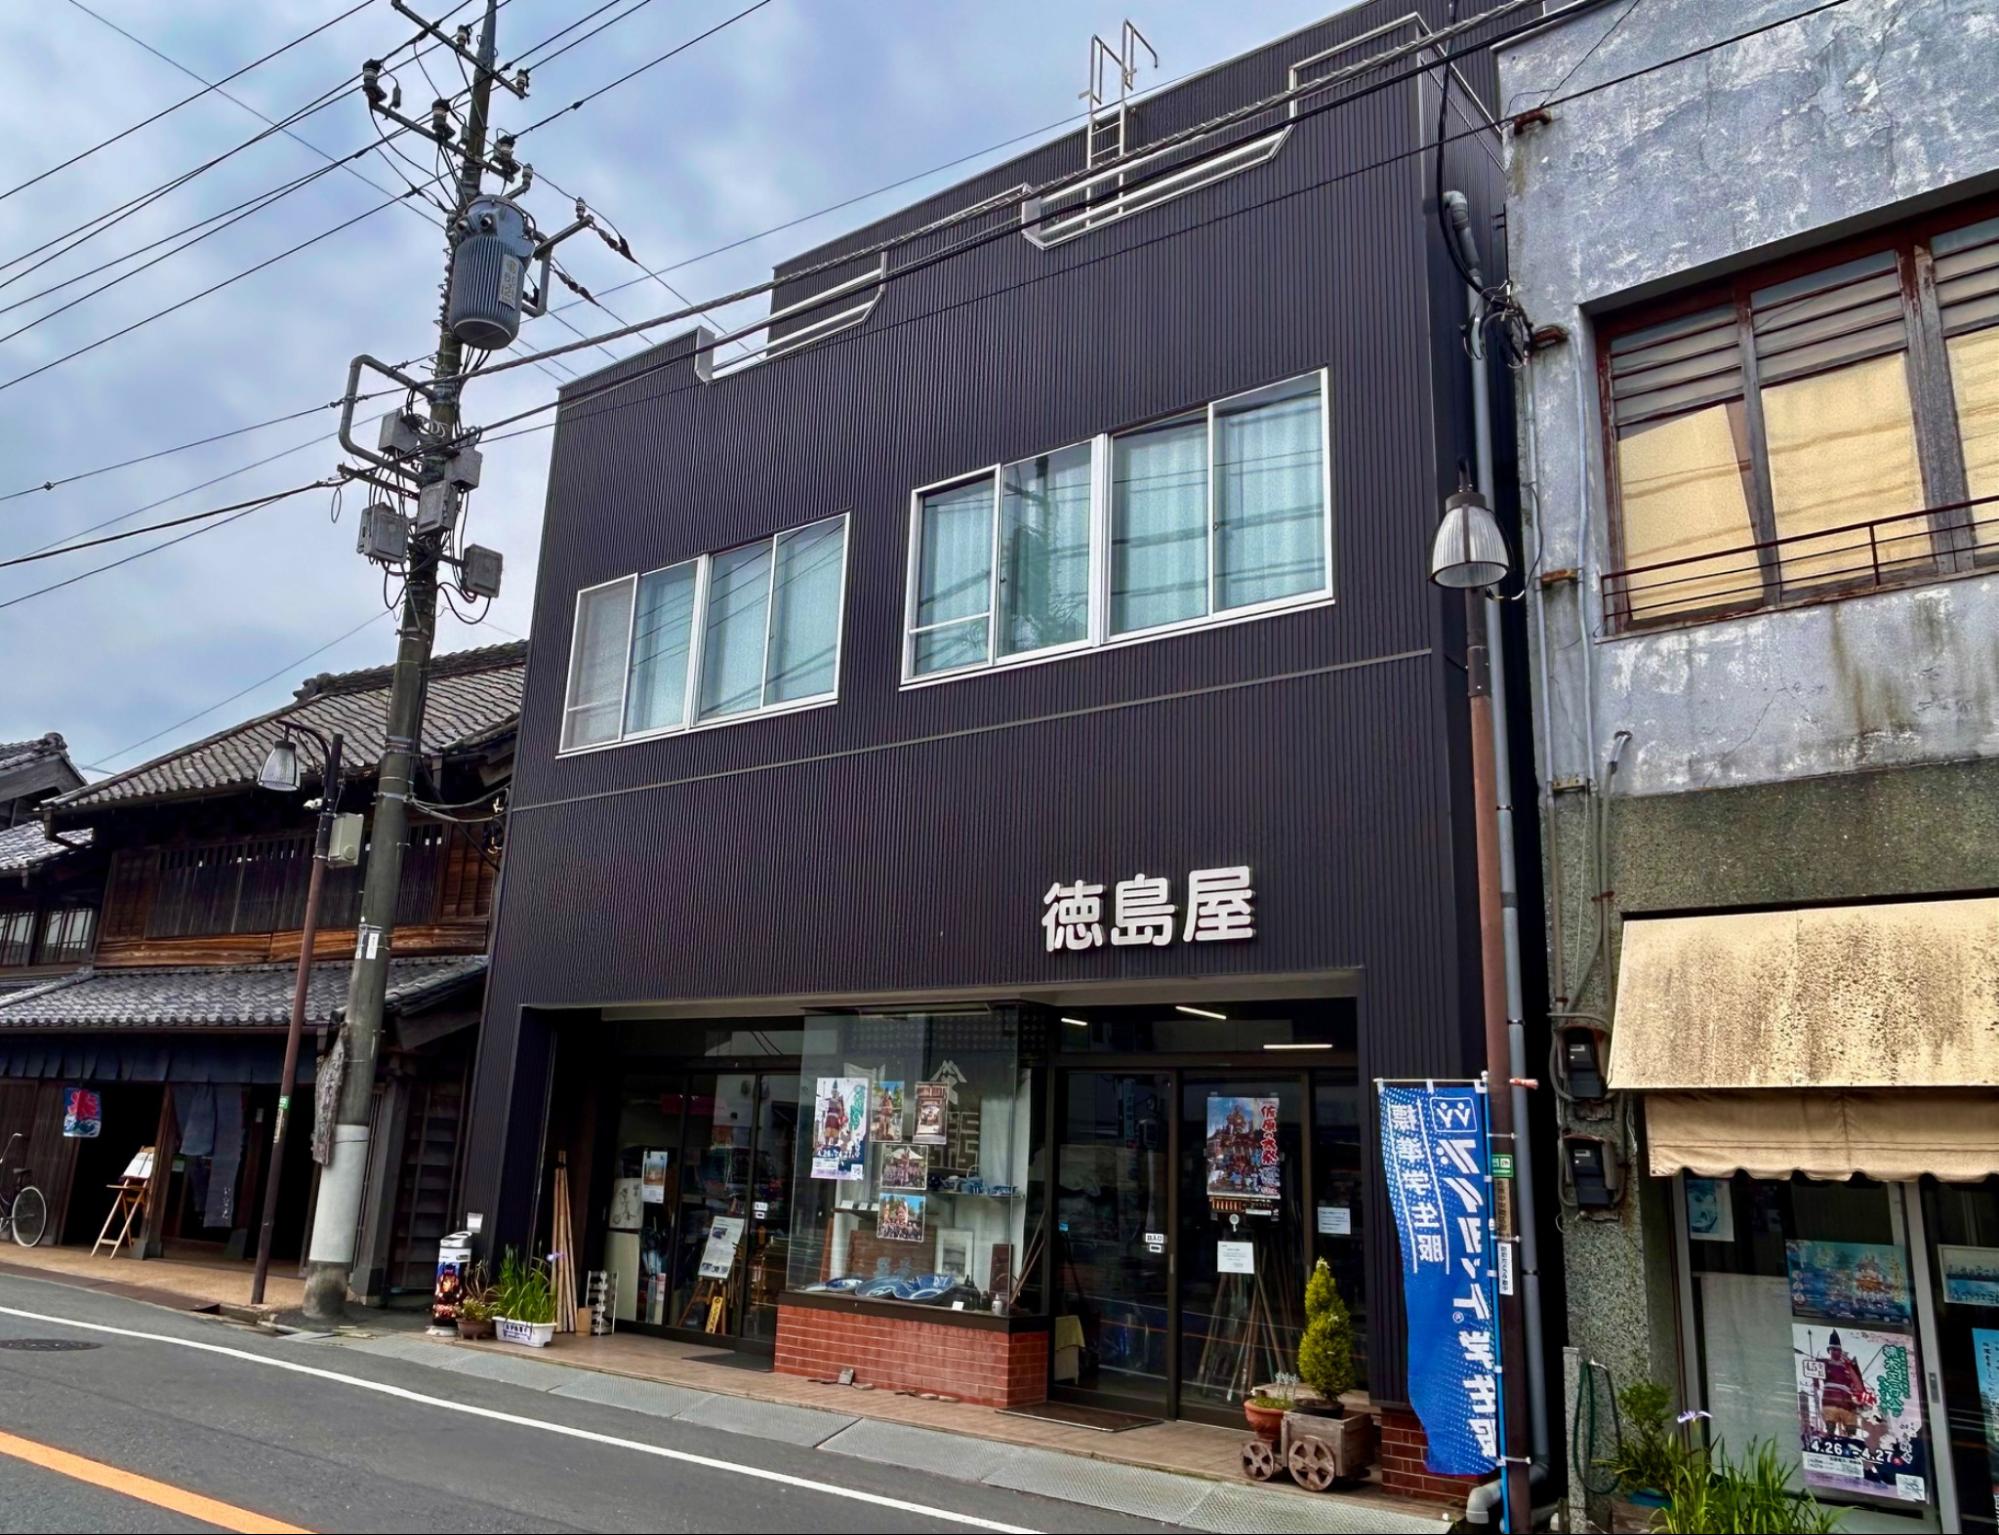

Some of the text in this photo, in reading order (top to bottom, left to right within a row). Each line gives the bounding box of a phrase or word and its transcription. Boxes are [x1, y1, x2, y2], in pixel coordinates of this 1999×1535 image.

[1041, 865, 1254, 953] 徳島屋
[1811, 1440, 1842, 1455] 4.26
